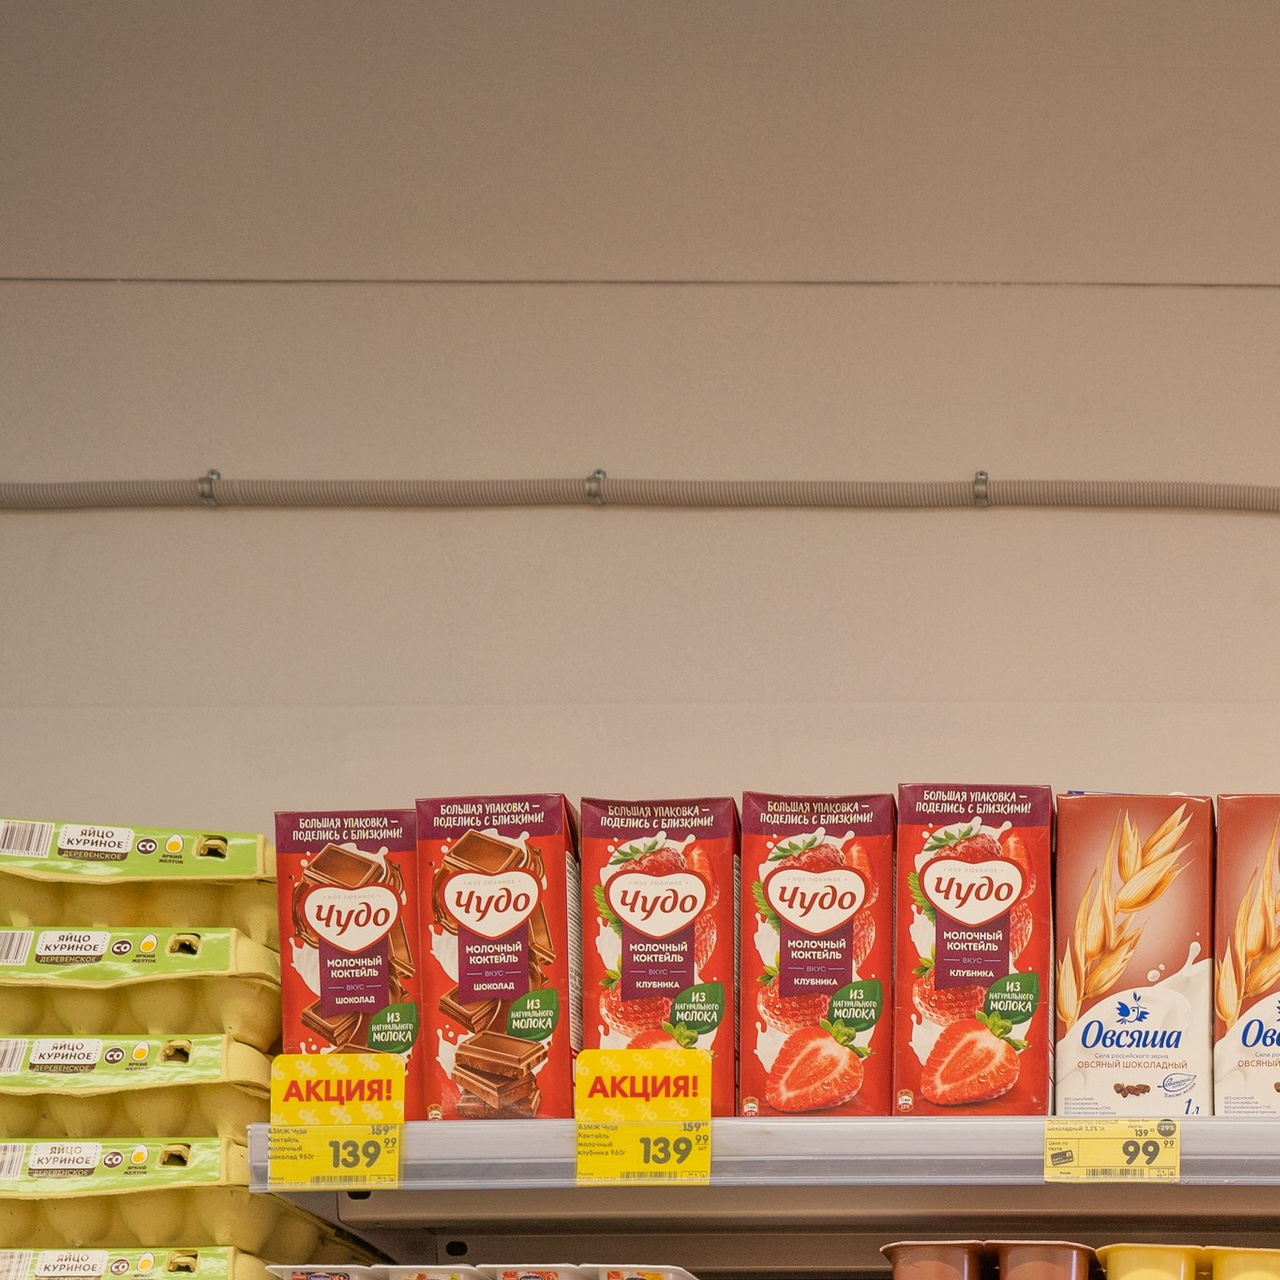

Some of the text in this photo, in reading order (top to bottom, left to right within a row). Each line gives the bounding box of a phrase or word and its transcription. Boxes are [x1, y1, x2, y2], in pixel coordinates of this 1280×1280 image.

[440, 802, 530, 816] БОЛЬШАЯ УПАКОВКА
[434, 815, 481, 828] ПОДЕЛИСЬ
[493, 812, 544, 826] БЛИЗКИМИ!
[80, 827, 115, 839] ЯЙЦО
[66, 838, 124, 849] КУРИНОЕ
[456, 887, 531, 922] Чудо
[466, 942, 522, 954] МОЛОЧНЫЙ
[470, 953, 518, 965] КОКТЕЙЛЬ
[950, 969, 994, 978] КЛУБНИКА
[474, 981, 514, 991] ШОКОЛАД
[527, 1000, 540, 1010] ИЗ
[512, 1017, 553, 1029] МОЛОКА
[1082, 1020, 1182, 1050] Овсяша
[1078, 1060, 1187, 1069] ОВСЯНЫЙ ШОКОЛАДНЫЙ
[282, 1079, 393, 1105] АКЦИЯ!
[329, 1141, 380, 1168] 139
[1123, 1140, 1159, 1164] 99
